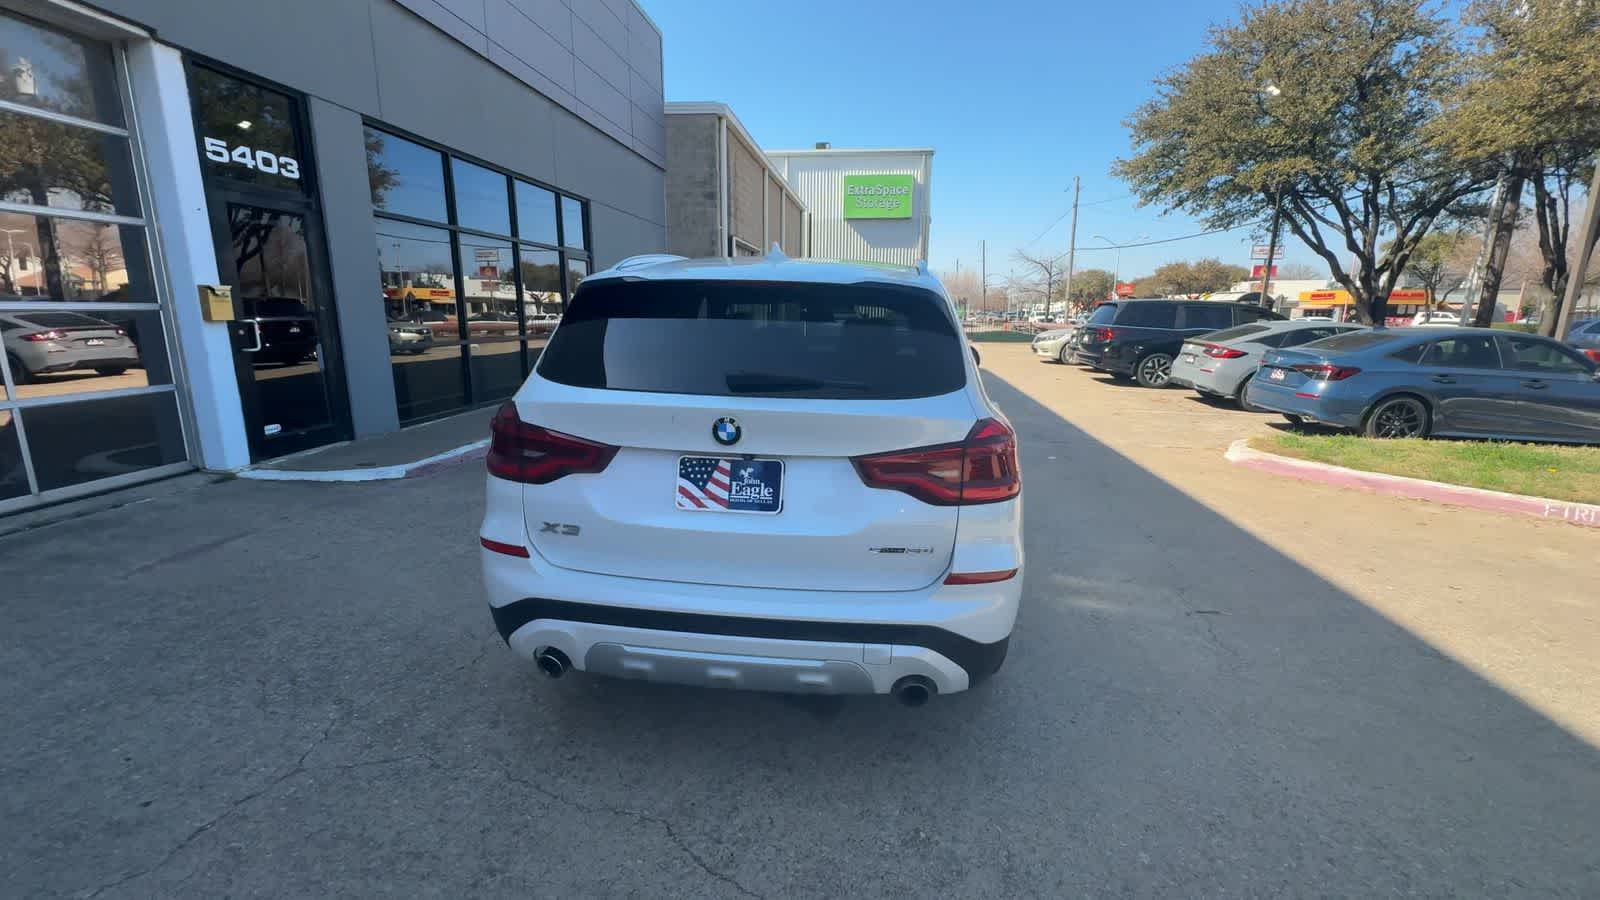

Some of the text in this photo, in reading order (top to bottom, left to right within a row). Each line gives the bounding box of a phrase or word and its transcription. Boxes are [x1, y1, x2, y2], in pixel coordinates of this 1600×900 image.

[204, 136, 300, 179] 5403
[855, 197, 901, 210] Storage
[743, 478, 760, 486] John
[731, 481, 774, 500] Eagle
[540, 521, 581, 536] X3
